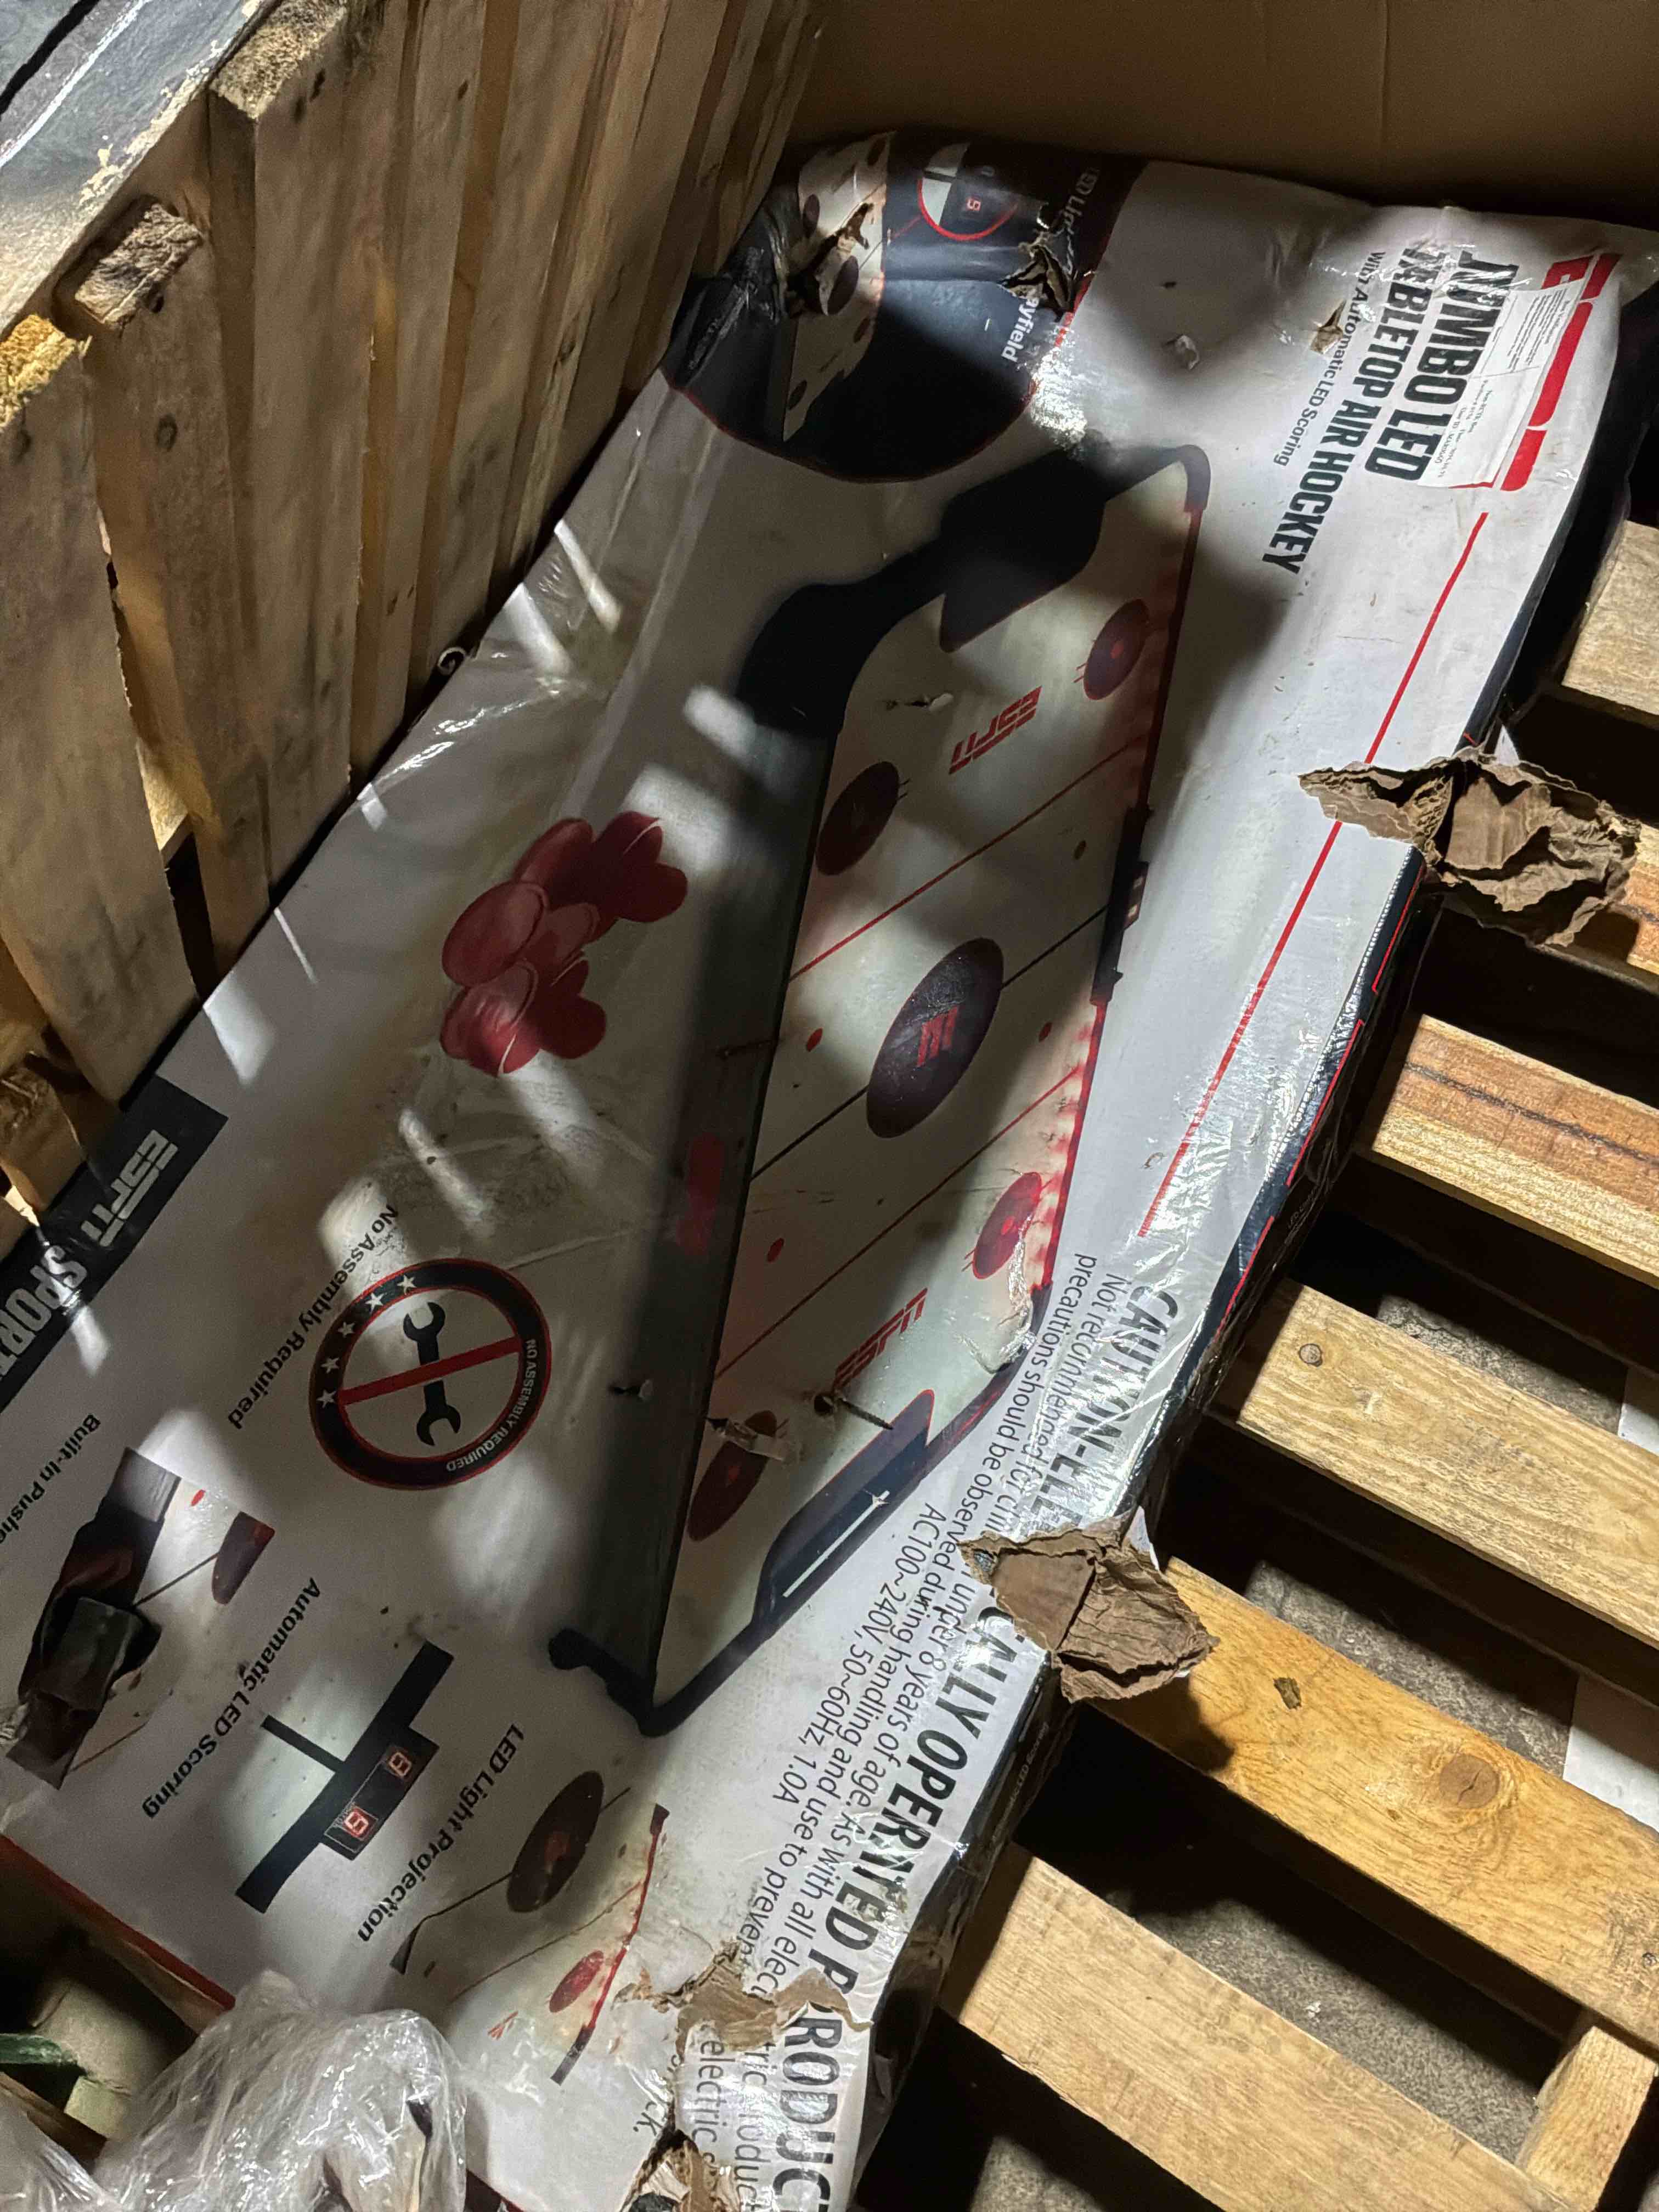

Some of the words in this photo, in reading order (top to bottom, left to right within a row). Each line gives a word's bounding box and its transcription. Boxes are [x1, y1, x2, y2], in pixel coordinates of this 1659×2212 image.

[1323, 287, 1367, 378] Automatic
[1352, 247, 1446, 399] TABLETOP
[1404, 250, 1519, 405] JUMBO
[1307, 380, 1331, 406] LED
[1321, 399, 1380, 449] AIR
[1273, 407, 1317, 466] Scoring
[1365, 409, 1451, 481] LED
[1261, 450, 1356, 575] HOCKEY
[81, 1129, 178, 1247] ESPN
[371, 1206, 399, 1234] No
[298, 1232, 375, 1334] Assembly
[1030, 1254, 1097, 1368] precautions
[1091, 1273, 1129, 1312] Not
[228, 1335, 305, 1429] Required
[524, 1339, 537, 1359] NO
[504, 1360, 536, 1430] ASSEMBLY
[996, 1371, 1040, 1442] should
[40, 1413, 101, 1480] Built-In
[446, 1426, 508, 1472] REQUIRED
[981, 1441, 1012, 1470] be
[933, 1474, 993, 1571] observed
[855, 1503, 944, 1643] AC100~240V,
[244, 1577, 321, 1694] Automatic
[889, 1571, 945, 1644] during
[927, 1583, 974, 1650] under
[918, 1650, 946, 1671] 8
[217, 1691, 251, 1738] LED
[799, 1643, 874, 1748] 50~60Hz,
[835, 1647, 911, 1745] handling
[884, 1666, 930, 1731] years
[142, 1737, 218, 1818] Scoring
[490, 1724, 525, 1776] LED
[772, 1754, 817, 1798] 1.0A
[816, 1748, 851, 1797] and
[874, 1730, 900, 1767] of
[447, 1773, 495, 1832] Light
[845, 1756, 887, 1809] age.
[791, 1797, 825, 1839] use
[830, 1812, 864, 1844] As
[358, 1827, 455, 1943] Projection
[777, 1843, 803, 1867] to
[799, 1849, 845, 1899] with
[789, 1901, 816, 1938] all
[692, 2040, 736, 2143] electric
[773, 1948, 860, 2212] PRODUC
